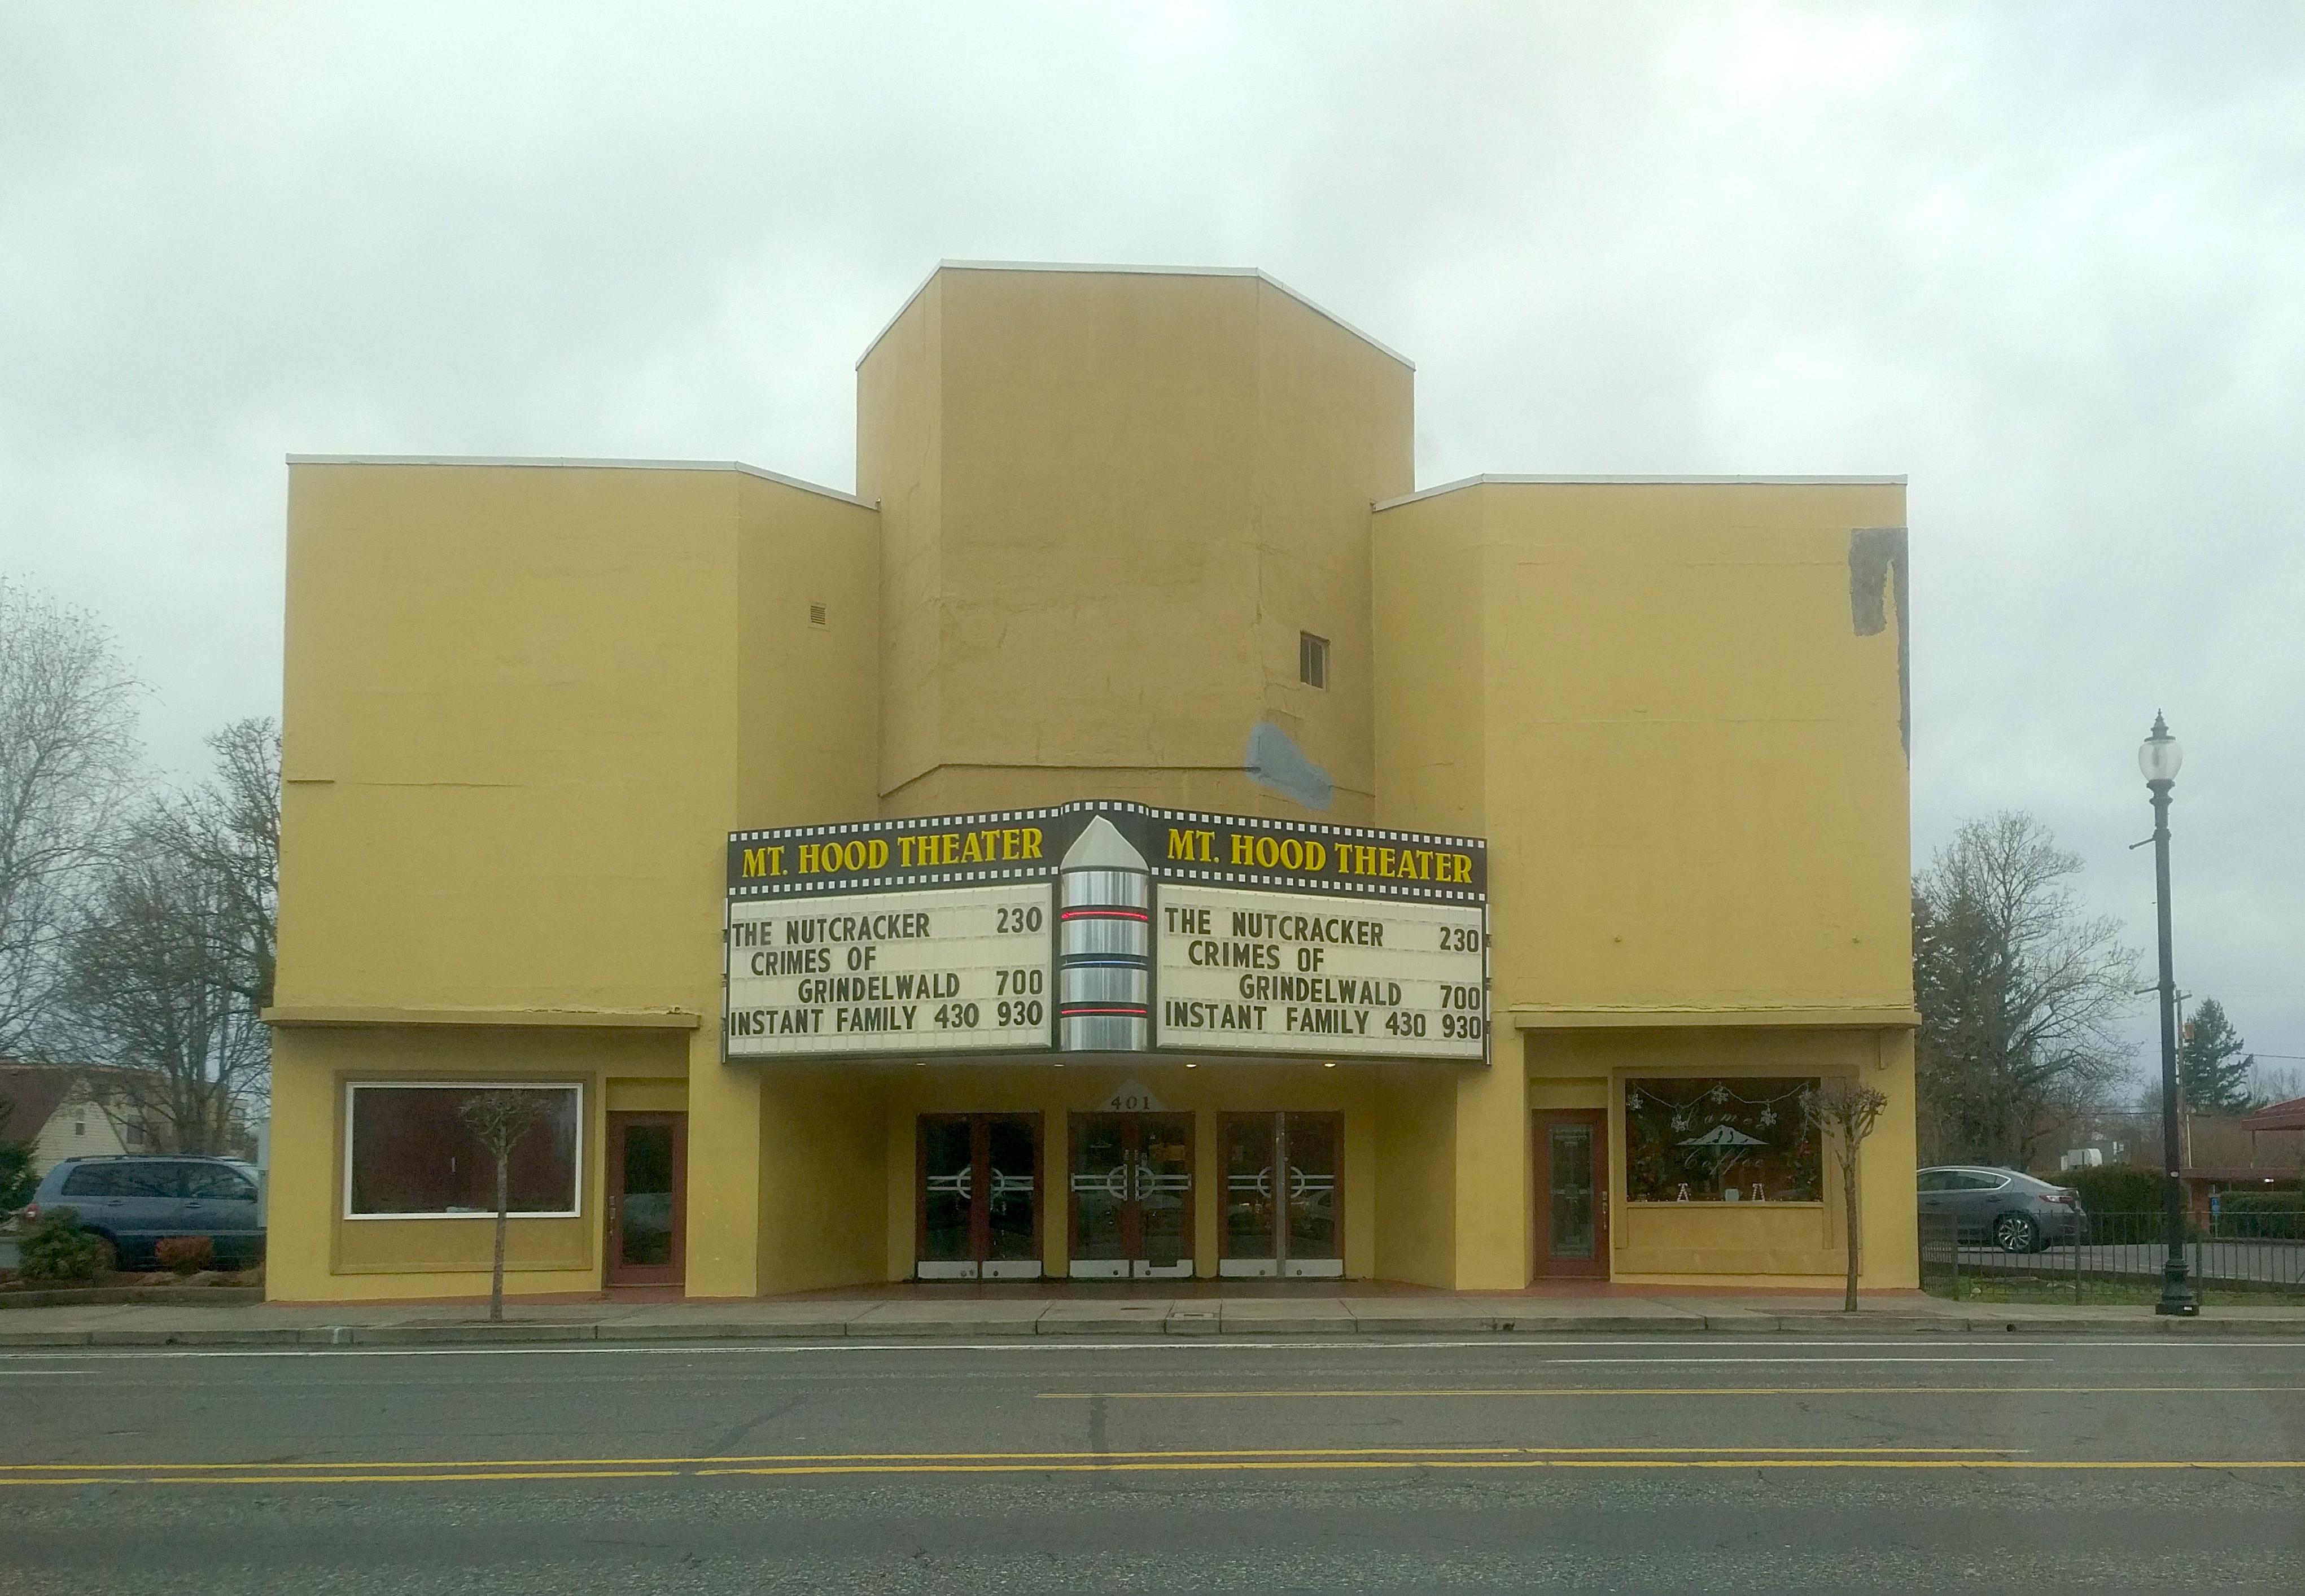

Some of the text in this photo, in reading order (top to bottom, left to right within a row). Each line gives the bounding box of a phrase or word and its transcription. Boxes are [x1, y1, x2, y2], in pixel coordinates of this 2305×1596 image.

[742, 828, 1042, 877] MT. HOOD THEATER
[1168, 828, 1472, 884] MT. HOOD THEATER
[732, 907, 1042, 947] THE NUTCRACKER 230
[1165, 908, 1479, 952] THE NUTCRACKER 230
[751, 946, 876, 976] CRIMES OF
[1189, 941, 1323, 972] CRIMES OF
[798, 970, 1042, 1003] GRINDELWALD 700
[1240, 974, 1480, 1010] GRINDELWALD 700
[731, 1000, 1042, 1035] INSTANT FAMILY 430 930
[1166, 1002, 1481, 1039] INSTANT FAMILY 430 930
[1110, 1096, 1150, 1110] 401
[1682, 1146, 1764, 1175] Coffee
